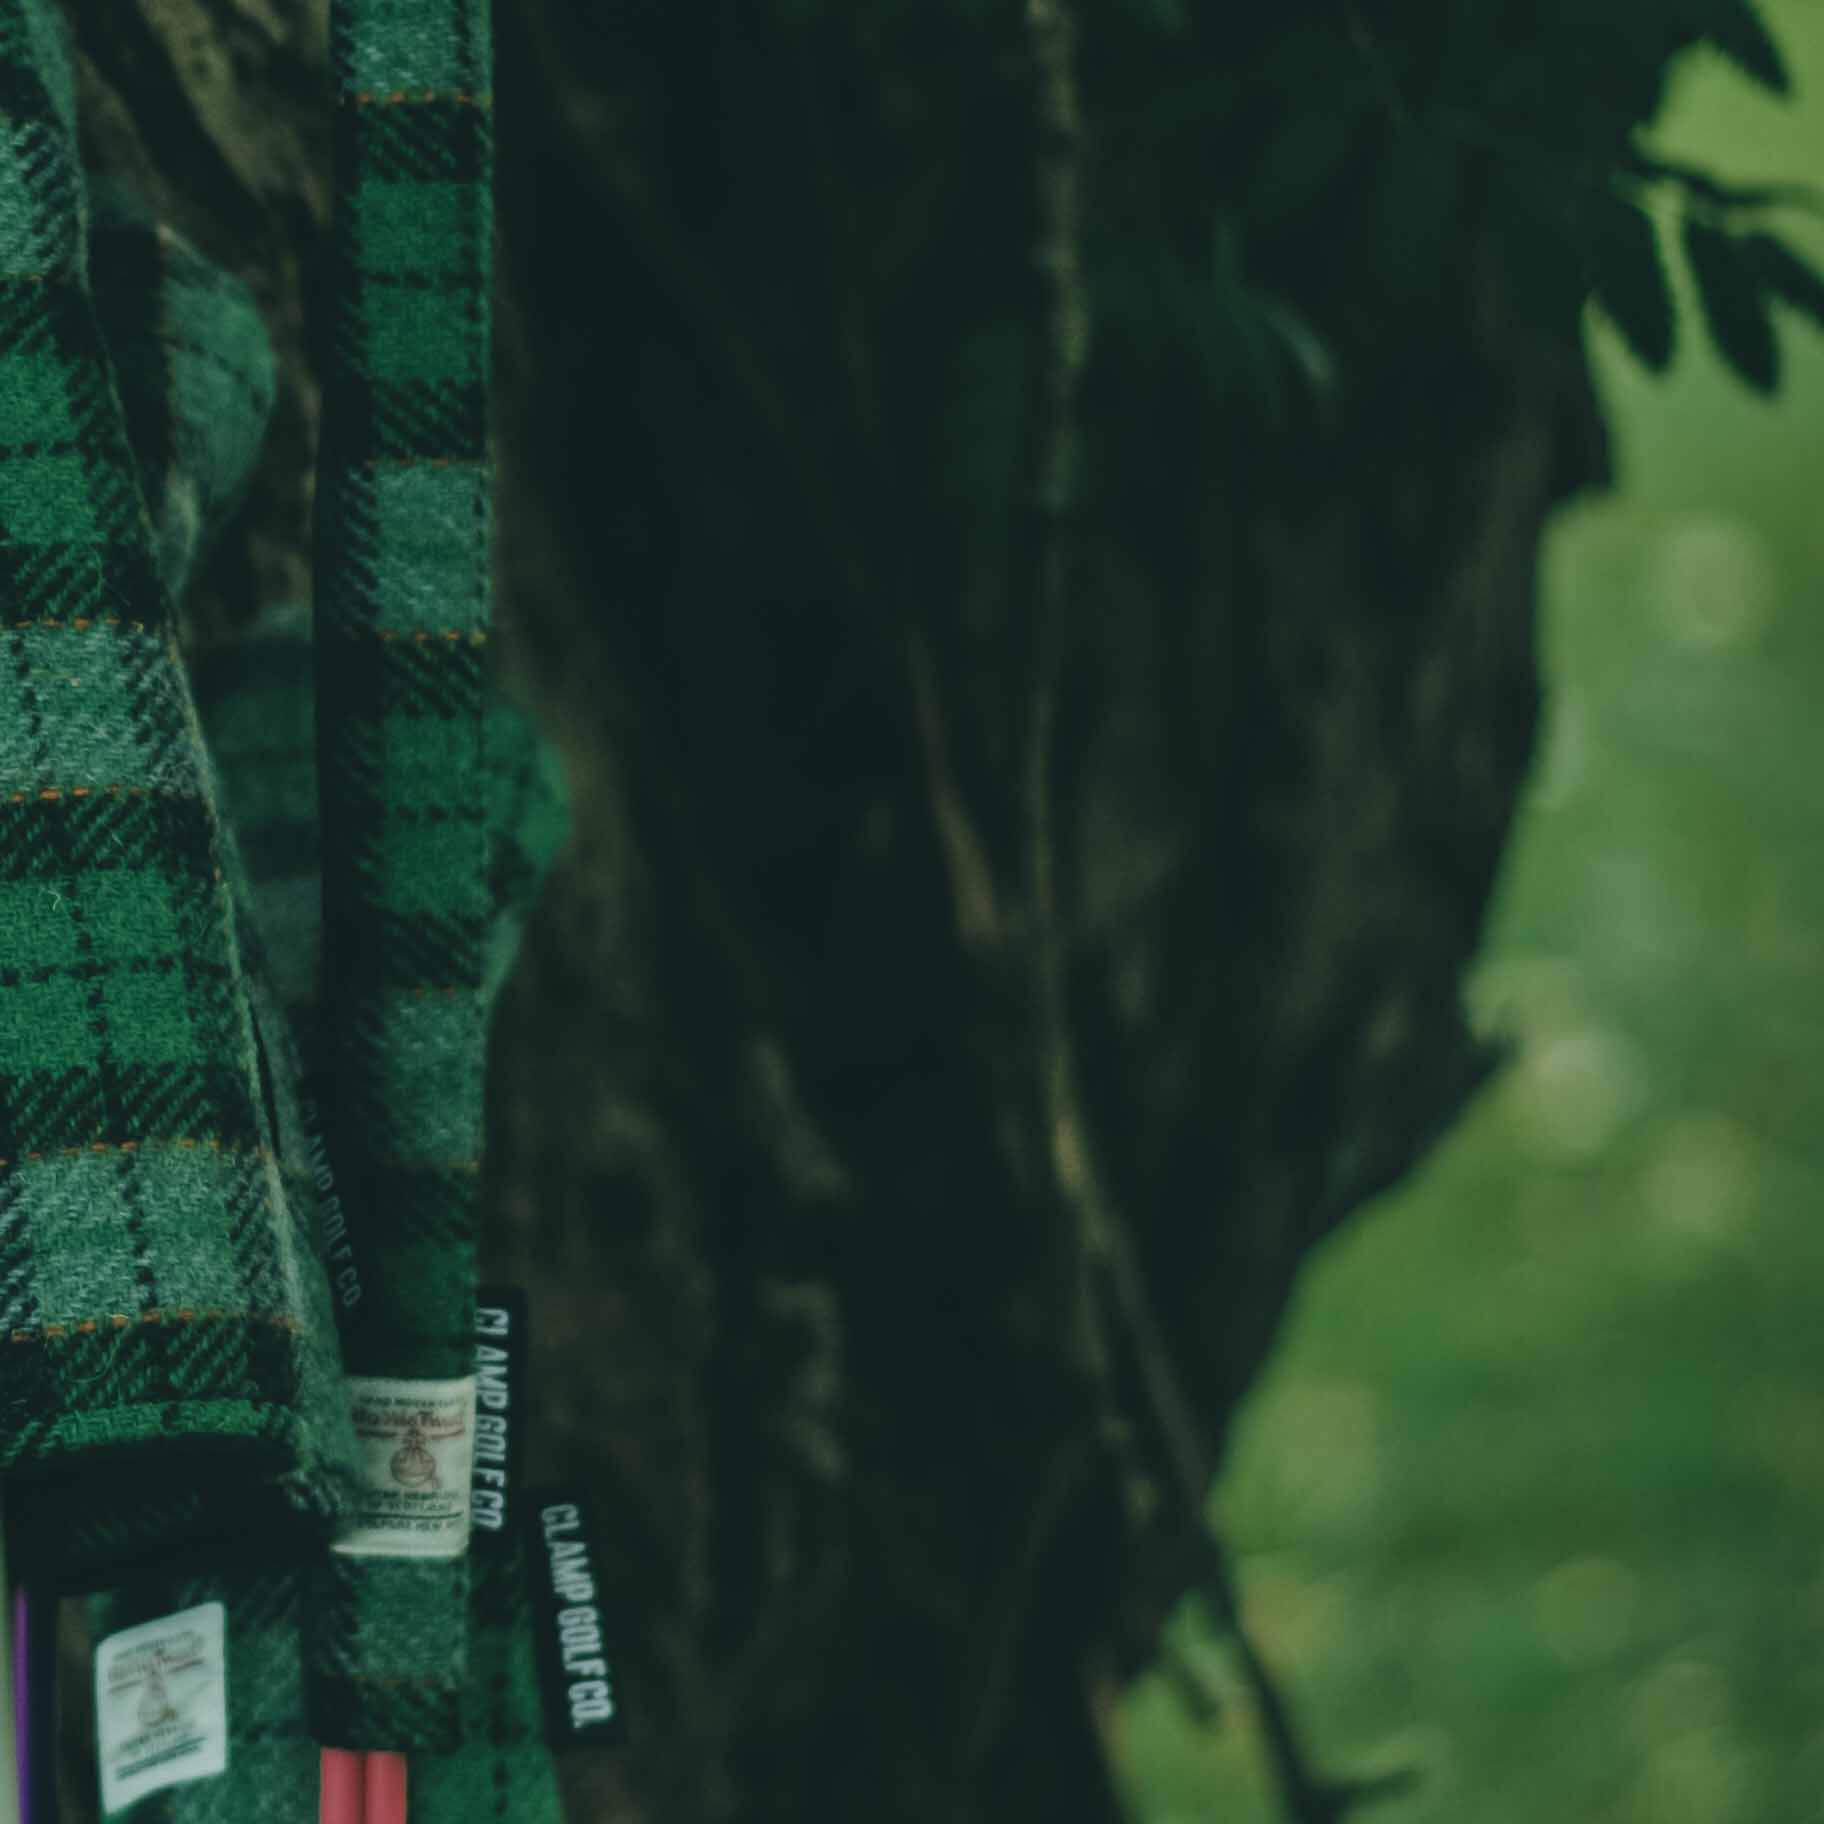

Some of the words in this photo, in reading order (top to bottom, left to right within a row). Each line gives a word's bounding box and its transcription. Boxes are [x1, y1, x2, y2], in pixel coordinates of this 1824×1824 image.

[475, 1415, 507, 1487] GOLF
[542, 1504, 594, 1602] CLAMP
[558, 1606, 606, 1675] GOLF
[568, 1680, 613, 1728] CO.
